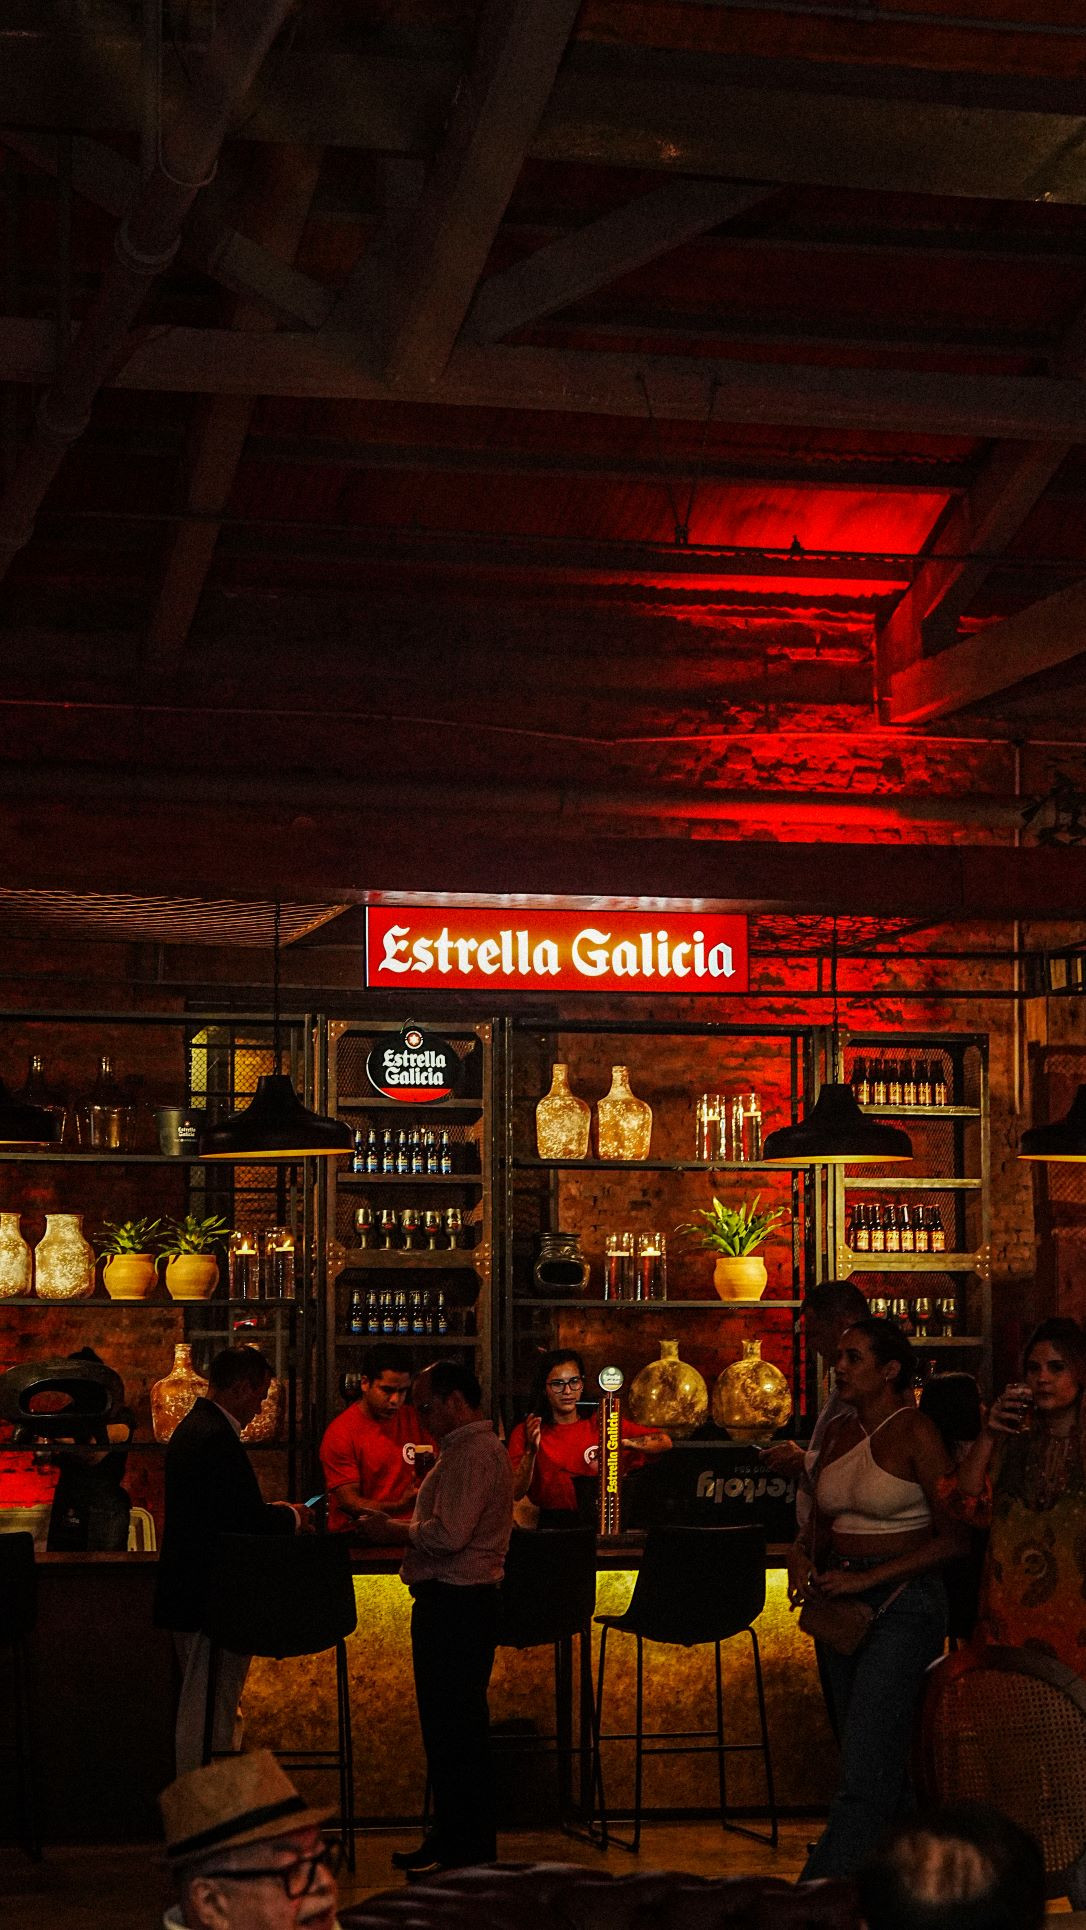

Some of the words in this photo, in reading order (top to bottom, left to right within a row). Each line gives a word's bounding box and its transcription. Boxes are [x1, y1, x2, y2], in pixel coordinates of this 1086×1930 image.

[378, 924, 562, 976] Estrella
[571, 928, 736, 979] Galicia
[382, 1049, 447, 1068] Estrella
[385, 1067, 444, 1086] Galicia
[607, 1411, 619, 1451] Galicia
[607, 1451, 619, 1493] Estrella
